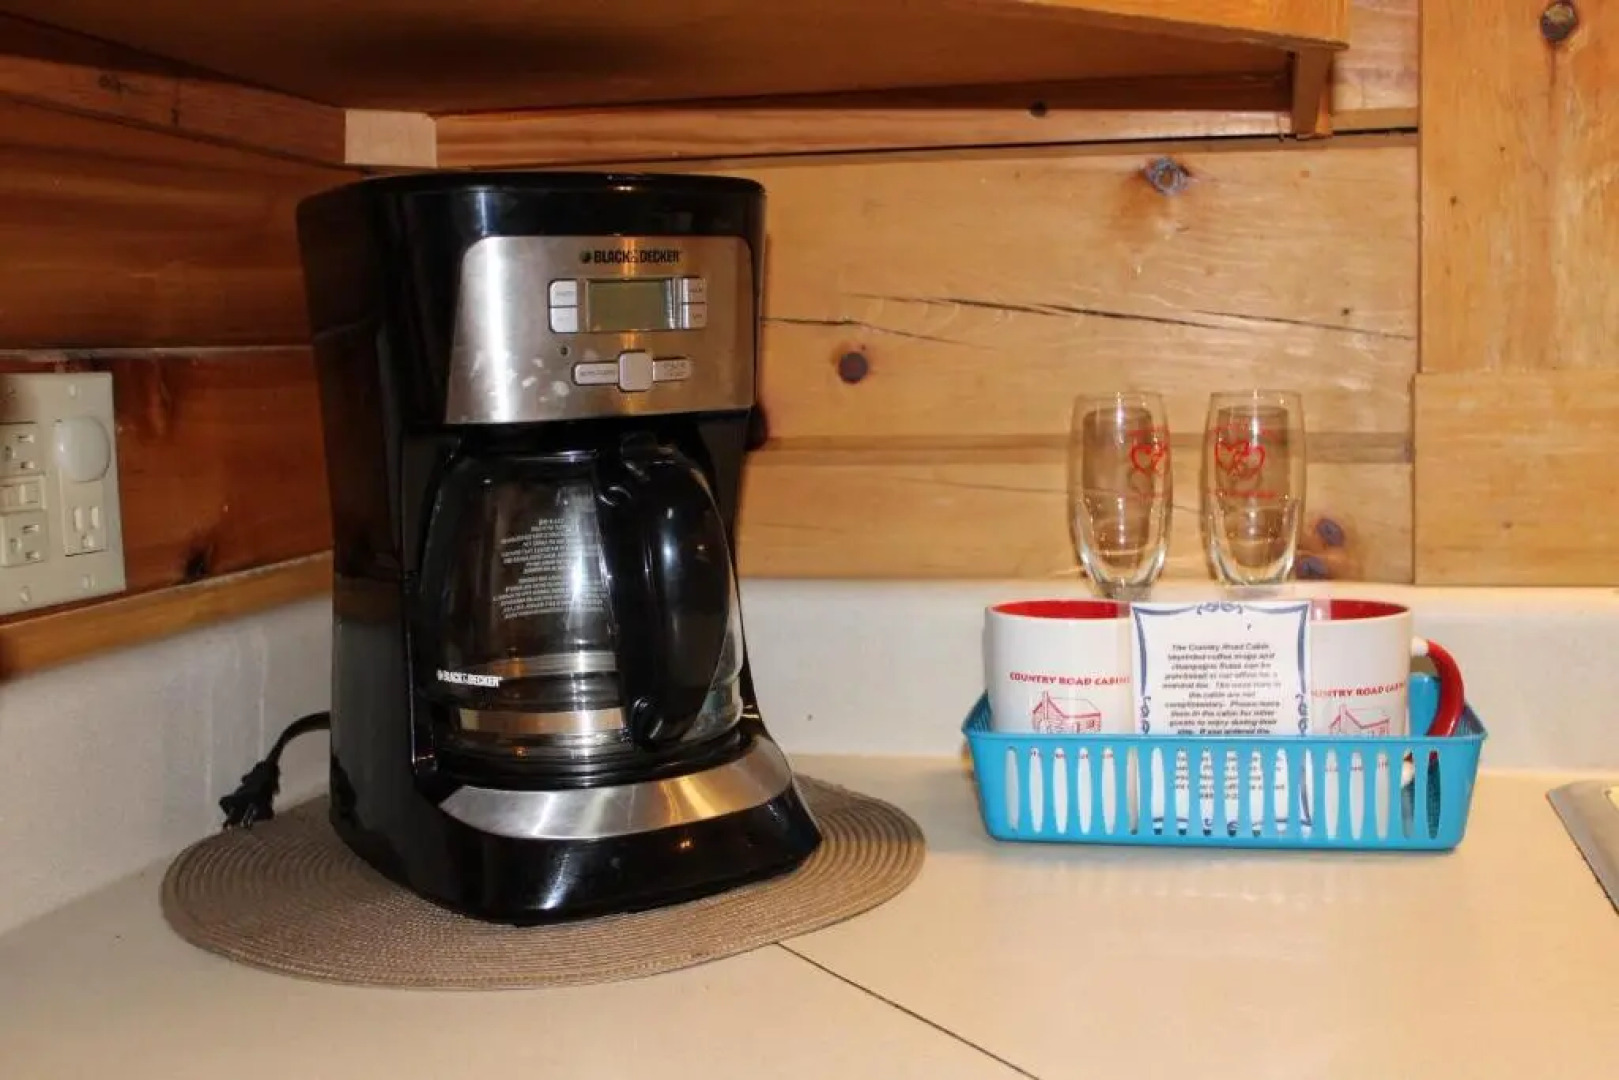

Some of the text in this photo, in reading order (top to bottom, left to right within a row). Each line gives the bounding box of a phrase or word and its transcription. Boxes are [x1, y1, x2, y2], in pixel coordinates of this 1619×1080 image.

[1010, 672, 1057, 684] COUNTRY
[1058, 676, 1093, 686] ROAD
[1355, 685, 1384, 697] ROAD
